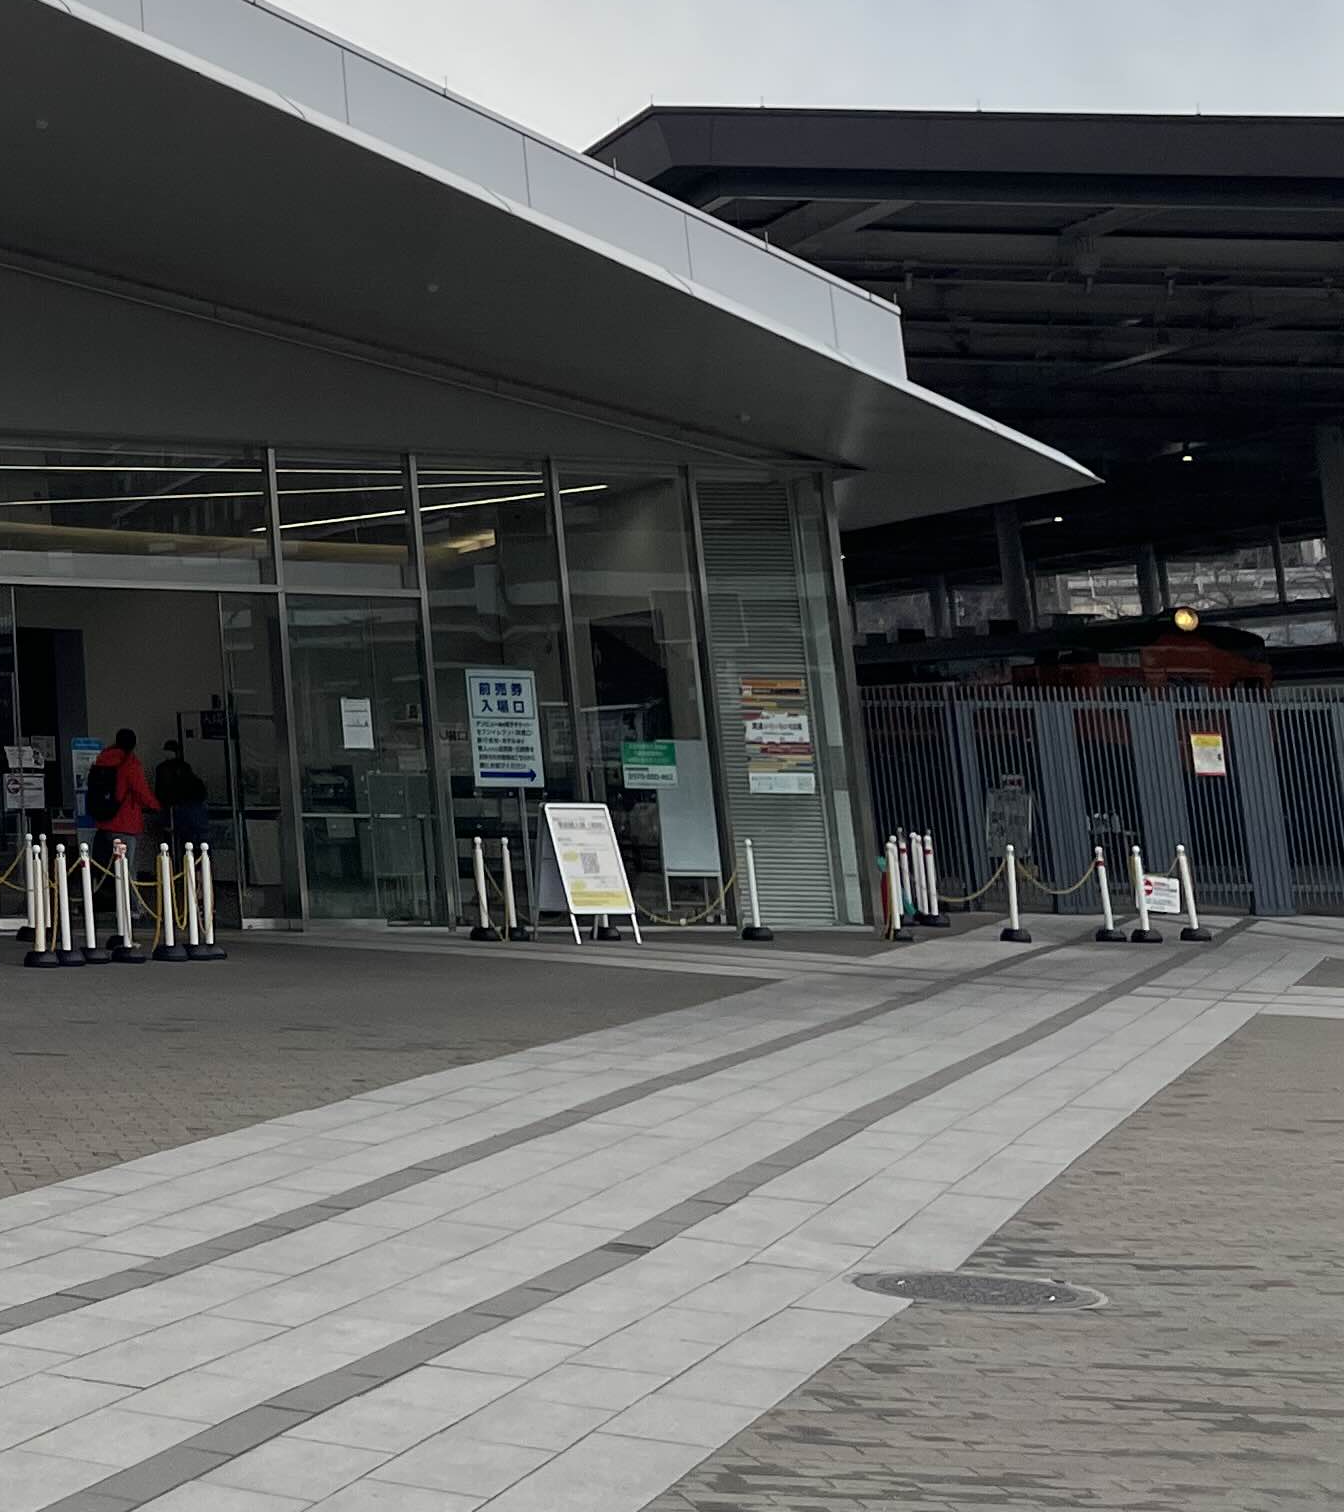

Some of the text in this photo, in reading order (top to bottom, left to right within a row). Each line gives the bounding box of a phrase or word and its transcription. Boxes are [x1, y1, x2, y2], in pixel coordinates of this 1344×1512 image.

[478, 682, 523, 697] 前売券
[480, 699, 525, 714] 入場口
